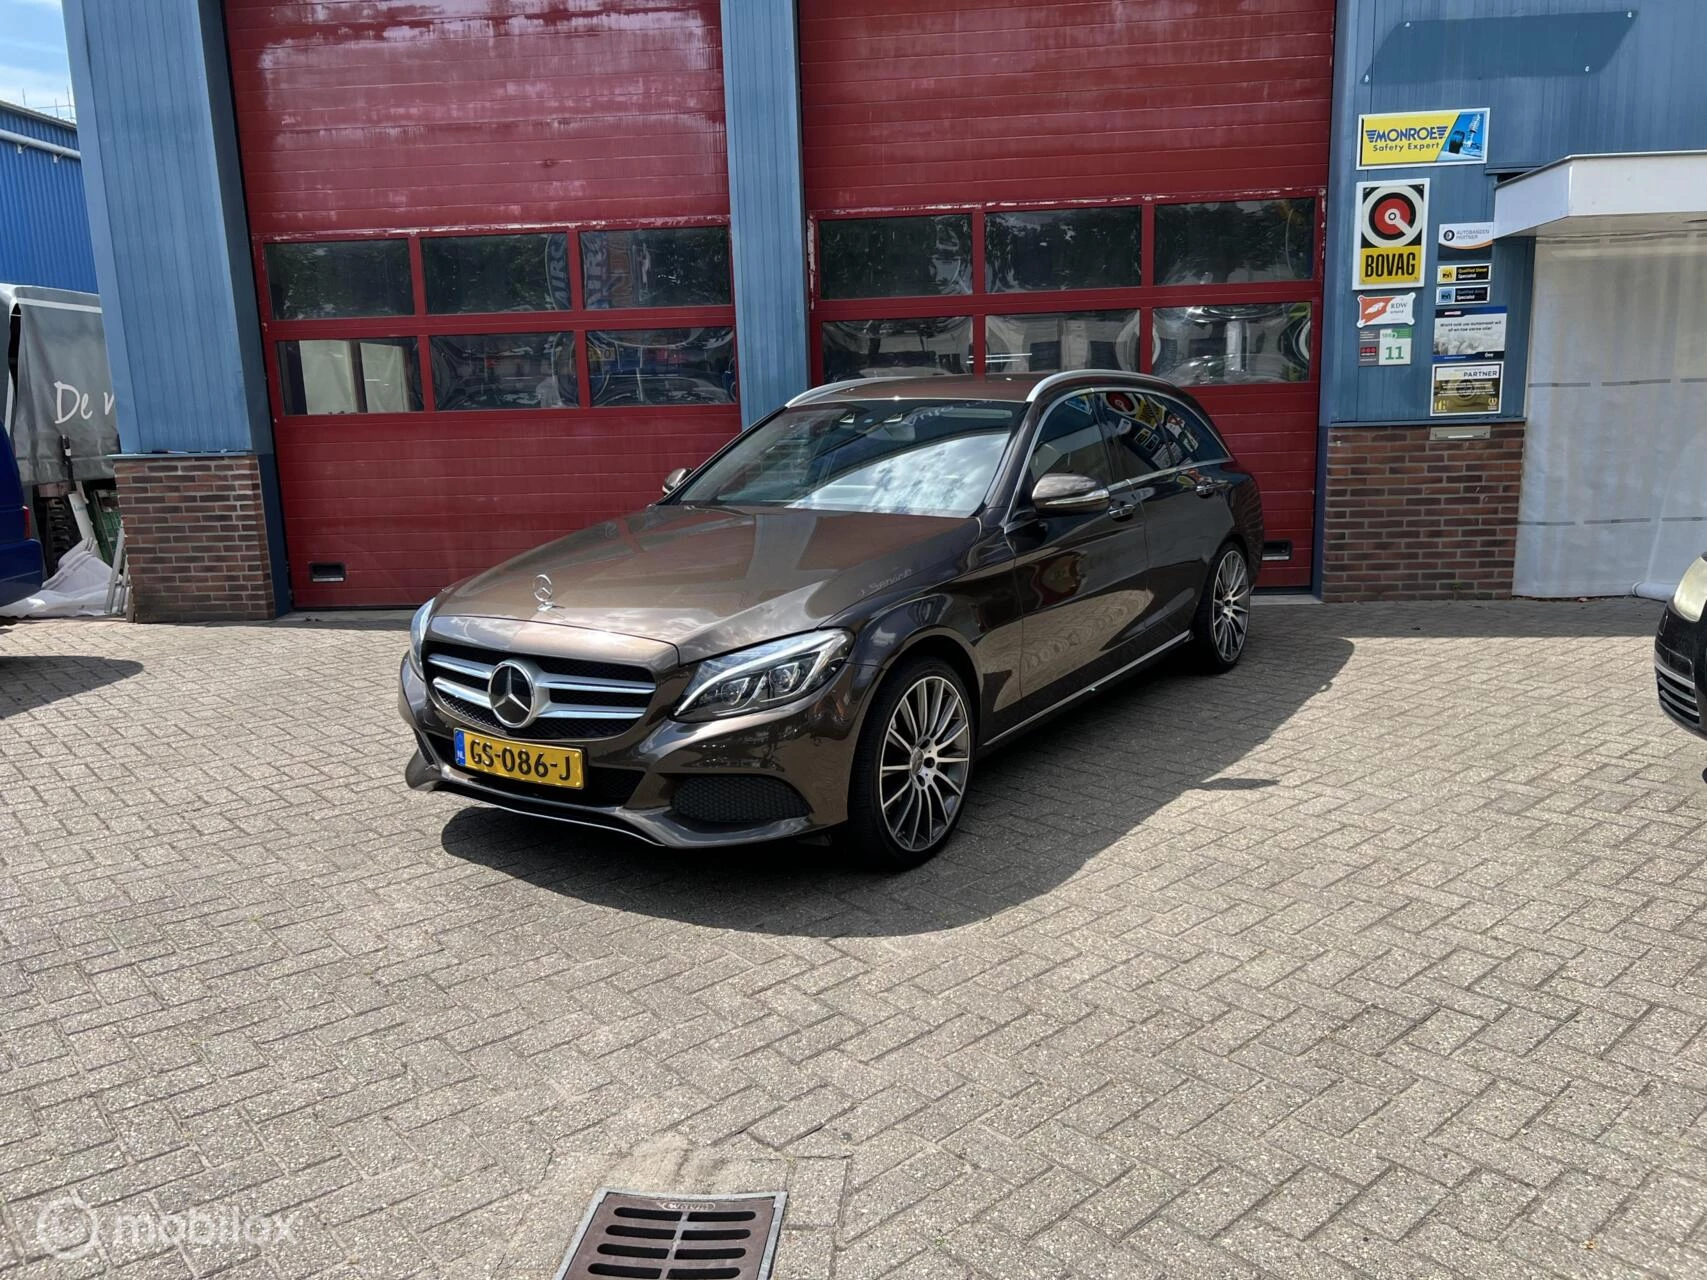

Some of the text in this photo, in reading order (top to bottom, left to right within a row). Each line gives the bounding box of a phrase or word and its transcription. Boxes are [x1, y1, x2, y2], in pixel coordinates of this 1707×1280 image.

[1375, 127, 1438, 142] MONROE
[1373, 141, 1440, 152] Safety Expert
[1364, 252, 1416, 277] BOVAG
[1385, 345, 1404, 360] 11
[1463, 370, 1498, 378] PARTNER
[54, 380, 93, 424] De
[469, 739, 572, 781] GS-086-J
